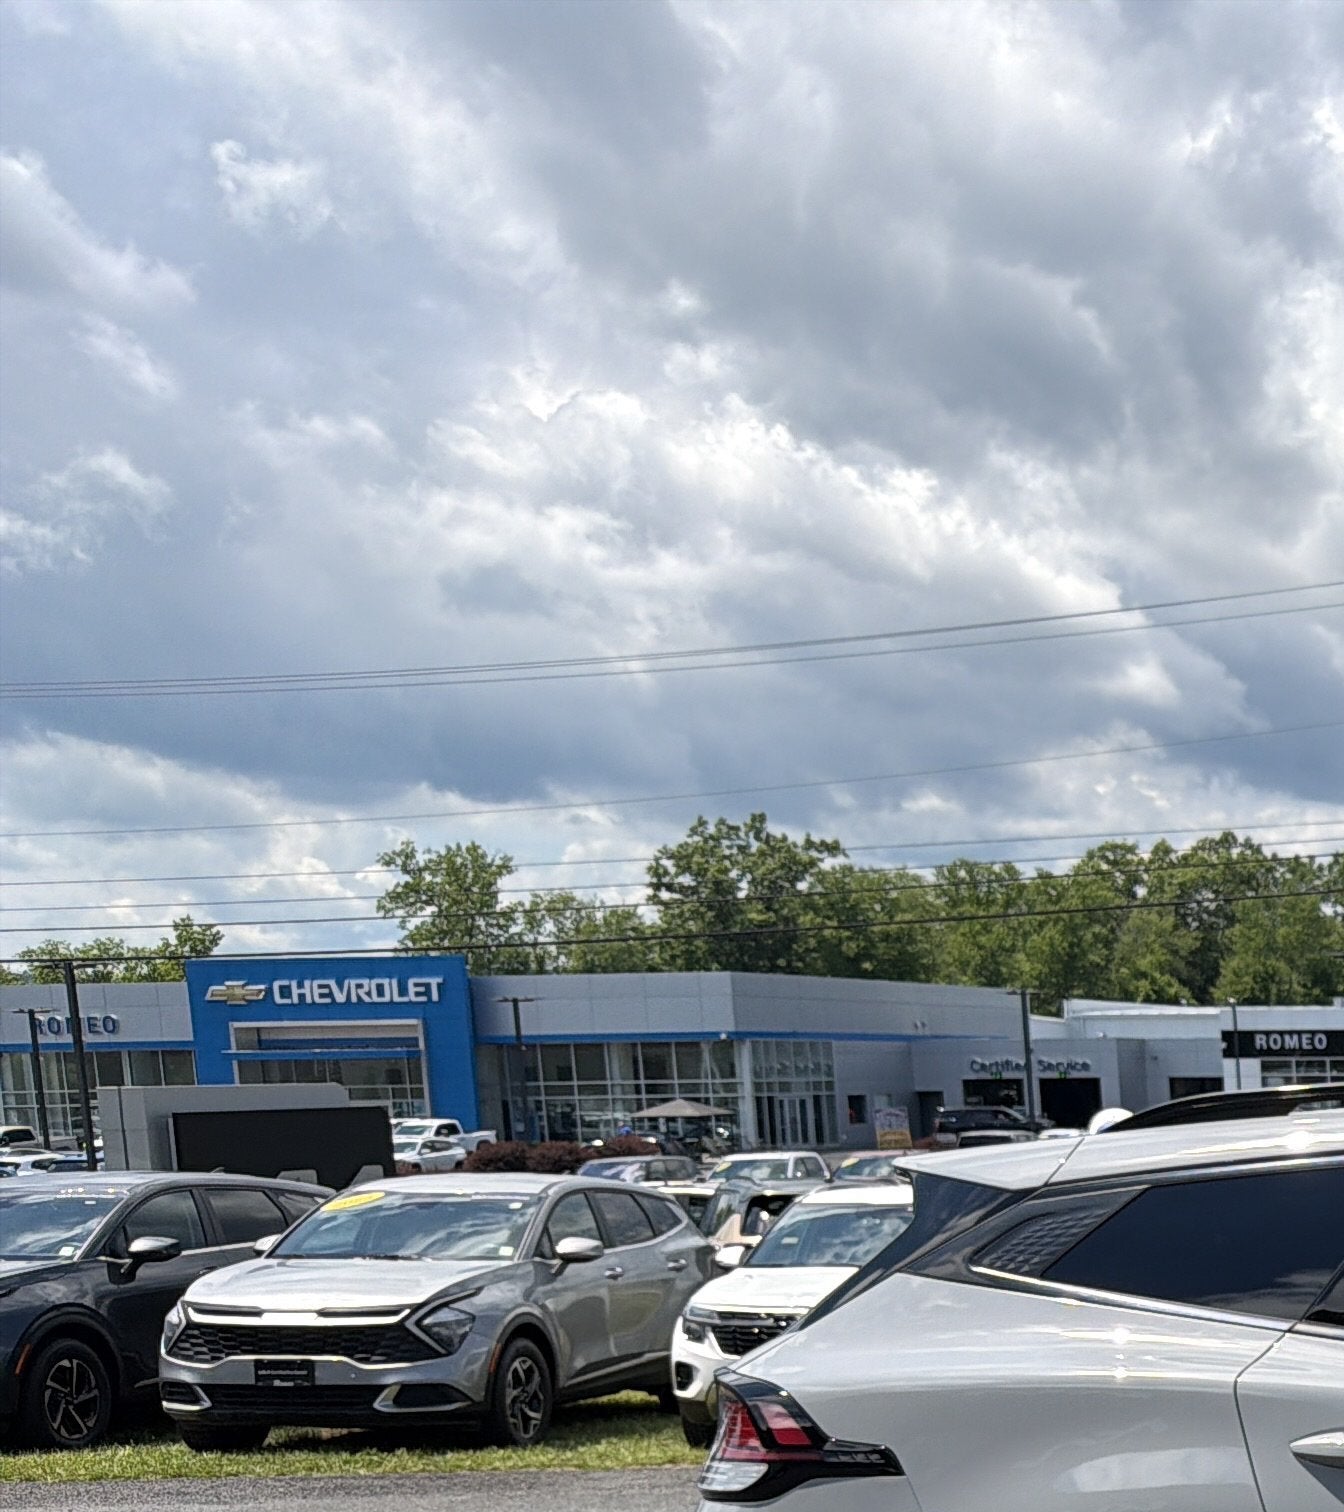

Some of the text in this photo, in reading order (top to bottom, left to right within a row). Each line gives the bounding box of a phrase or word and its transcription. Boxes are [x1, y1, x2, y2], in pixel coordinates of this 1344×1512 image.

[272, 976, 444, 1005] CHEVROLET
[1254, 1033, 1328, 1050] ROMEO
[969, 1059, 1090, 1075] Certifie Service
